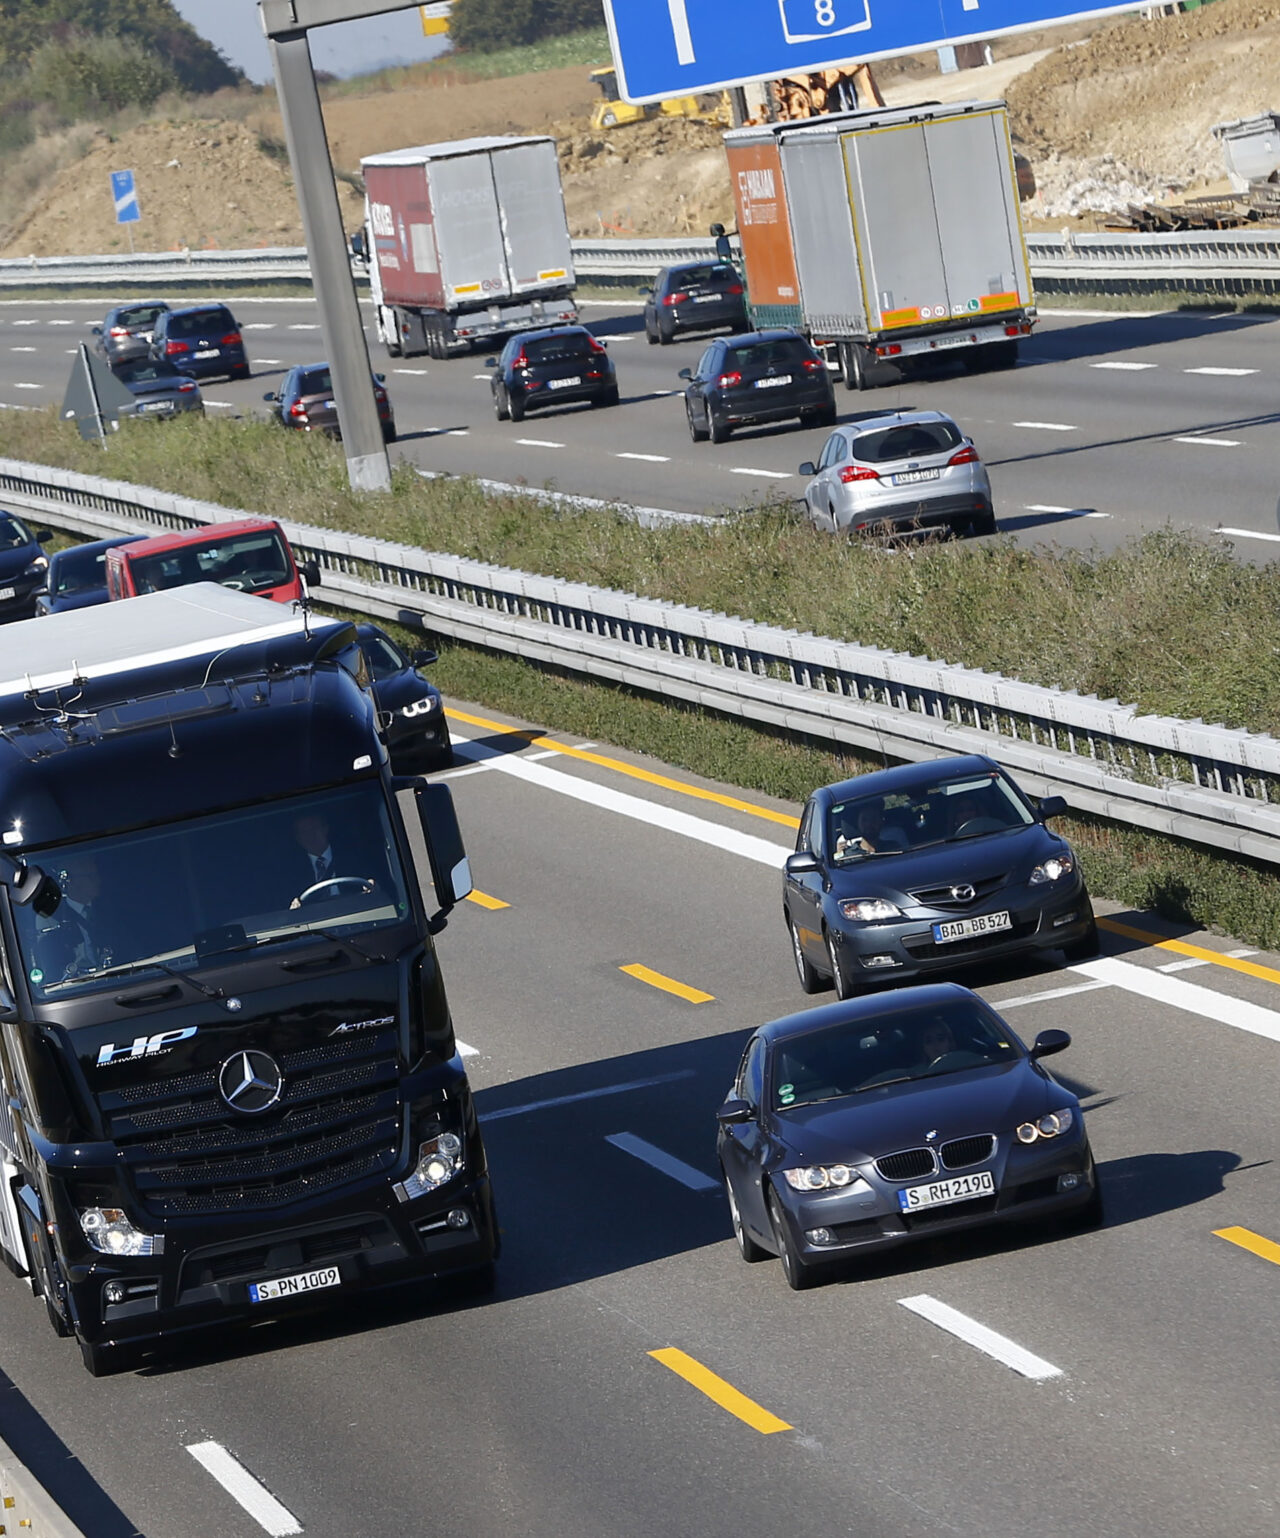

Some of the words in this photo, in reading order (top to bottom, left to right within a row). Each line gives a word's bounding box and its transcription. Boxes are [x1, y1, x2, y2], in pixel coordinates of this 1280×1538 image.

[815, 0, 836, 27] 8
[941, 922, 965, 938] BAD
[971, 918, 987, 932] BB
[987, 912, 1008, 928] 527
[95, 1053, 144, 1068] HIGHWAY
[144, 1047, 174, 1058] PILOT
[909, 1189, 920, 1205] S
[929, 1183, 951, 1201] RH
[952, 1174, 992, 1196] 2190
[259, 1284, 269, 1299] S
[277, 1277, 299, 1295] PN
[300, 1269, 337, 1291] 1009
